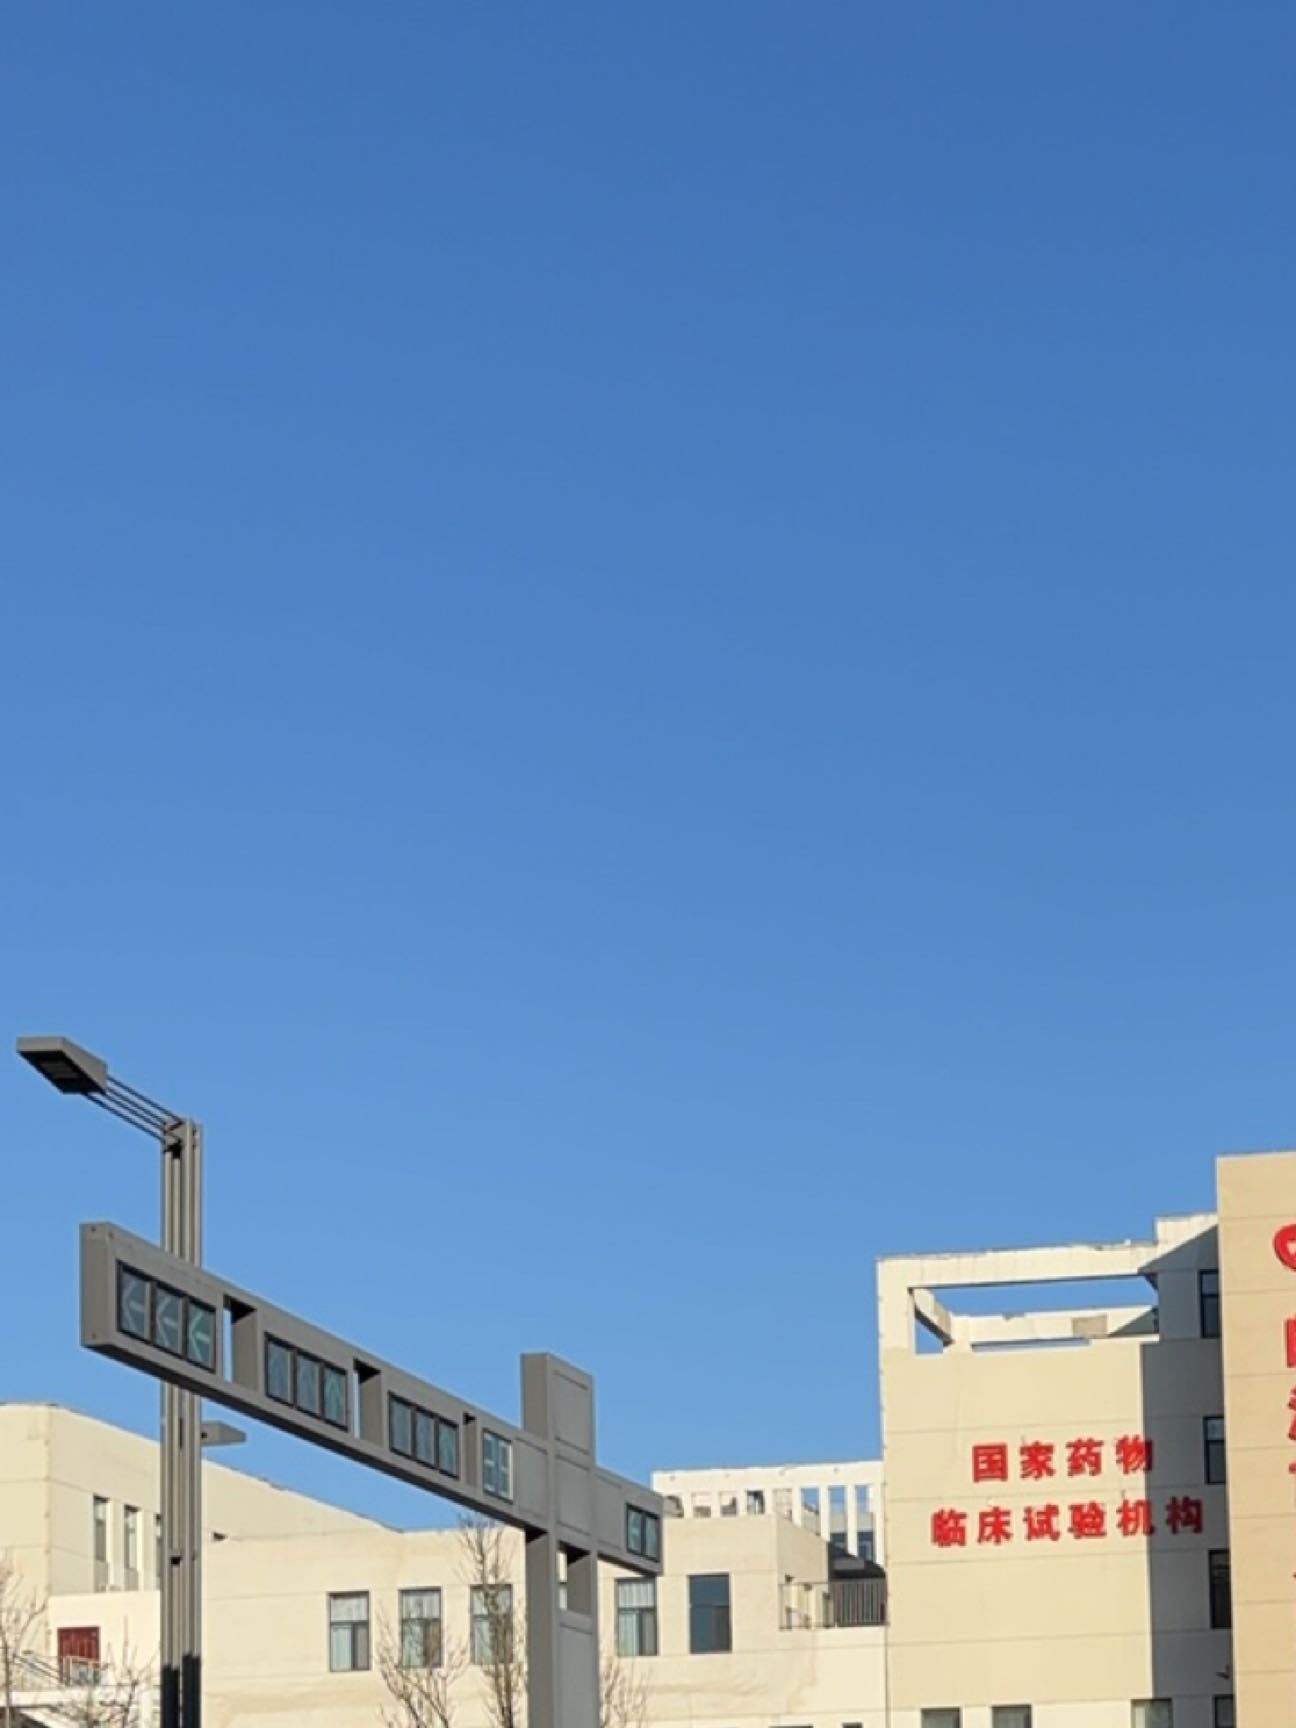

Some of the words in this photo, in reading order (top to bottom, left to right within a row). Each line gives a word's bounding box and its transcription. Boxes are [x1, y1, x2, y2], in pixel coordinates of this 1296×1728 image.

[971, 1435, 1154, 1483] 国家药物
[931, 1497, 1204, 1548] 临床试验机构
